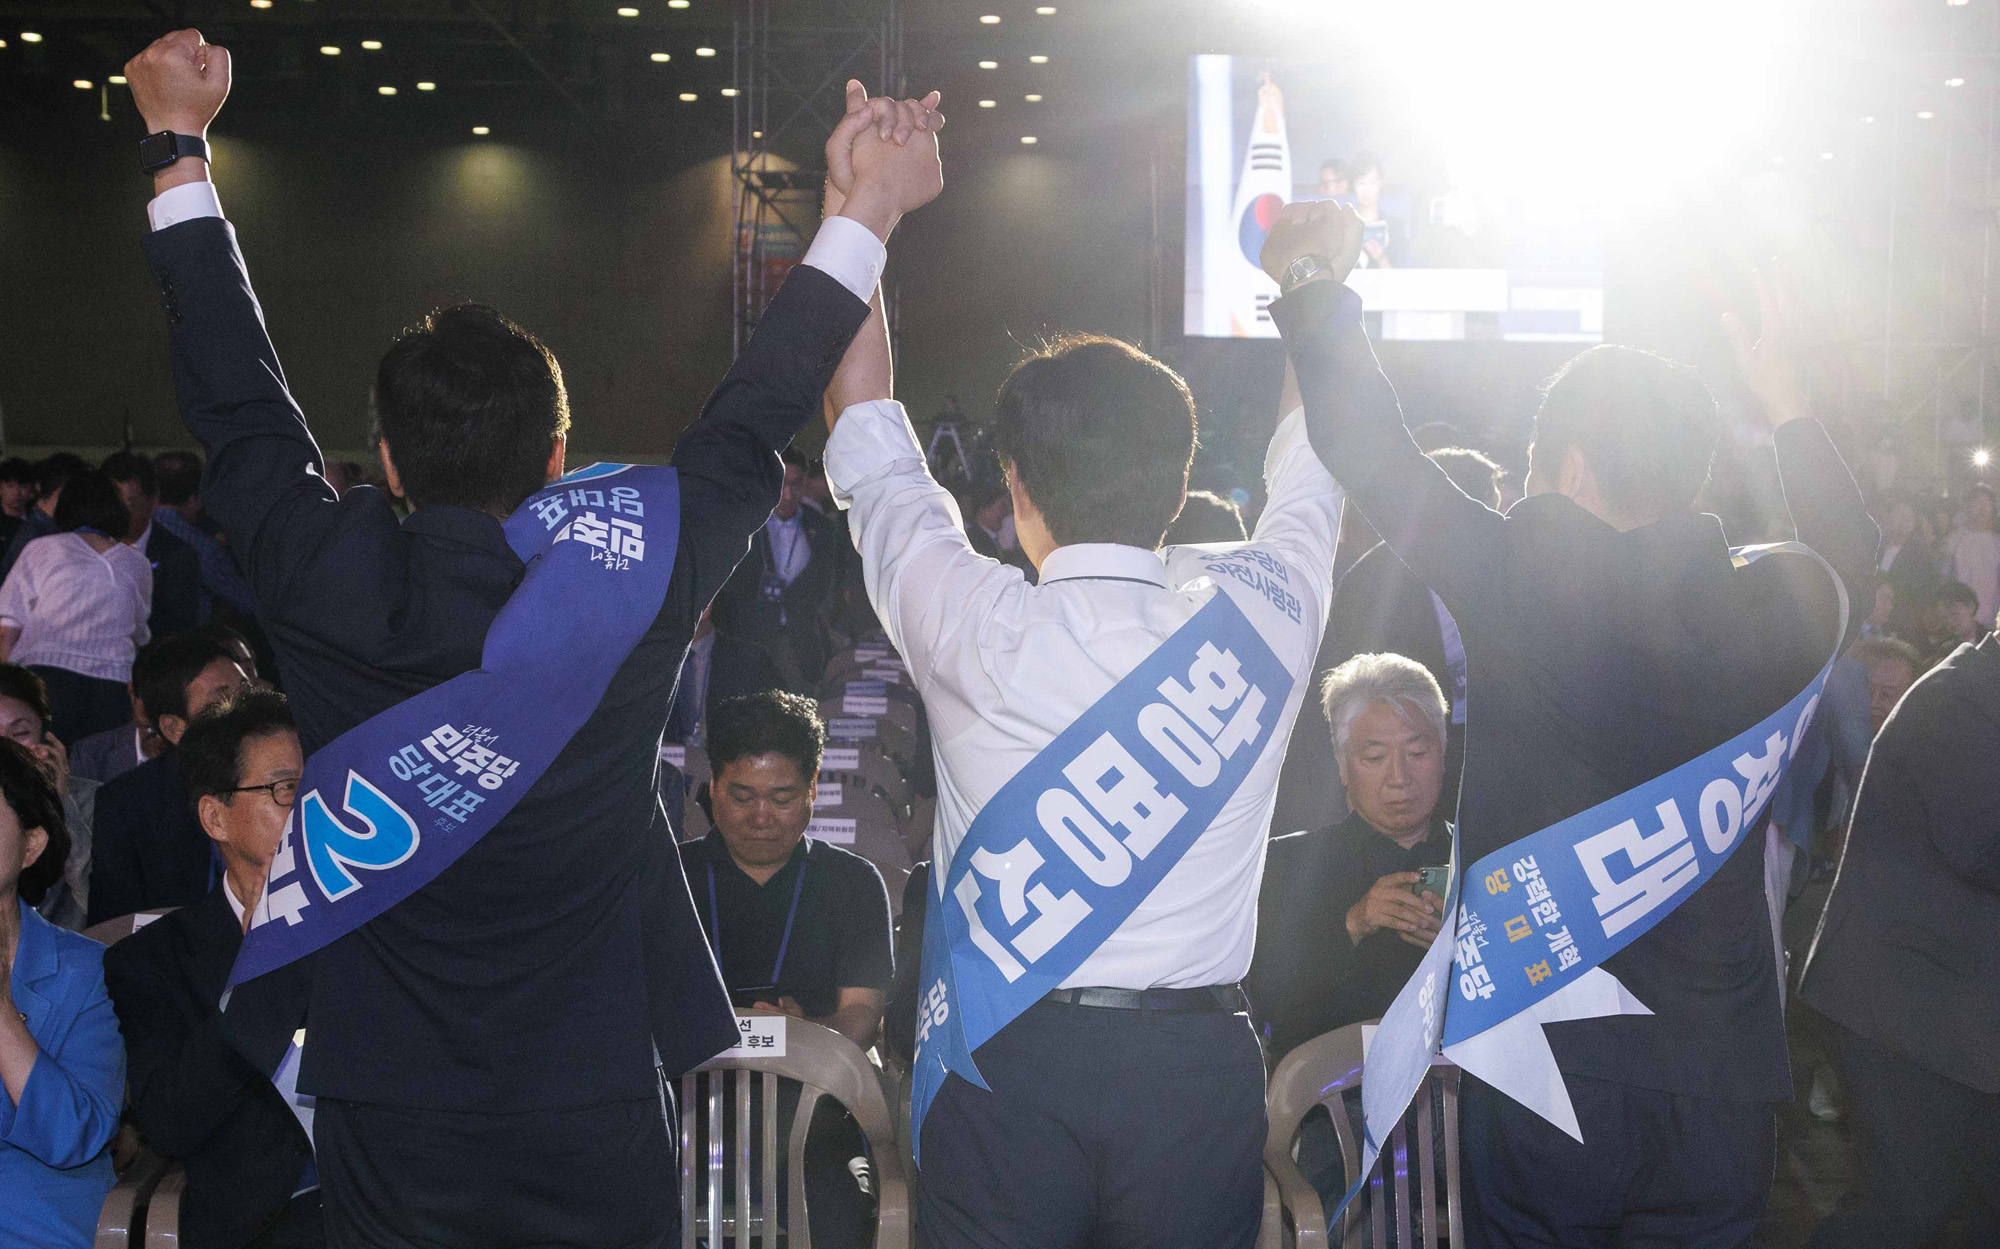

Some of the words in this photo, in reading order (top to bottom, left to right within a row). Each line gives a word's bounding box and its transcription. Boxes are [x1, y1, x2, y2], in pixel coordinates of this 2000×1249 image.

[529, 486, 644, 531] 당대표
[552, 511, 645, 562] 민주
[591, 546, 630, 571] 더불어
[1204, 562, 1302, 626] 야전사령관
[420, 723, 520, 790] 민주당
[462, 724, 499, 747] 더불어
[388, 744, 486, 823] 당대표
[301, 768, 421, 903] 2
[434, 816, 457, 833] 후보
[952, 640, 1267, 984] 황명선
[1468, 911, 1490, 948] 더불어
[1512, 854, 1562, 927] 강력한
[1545, 925, 1582, 972] 개혁
[747, 1034, 775, 1049] 후보
